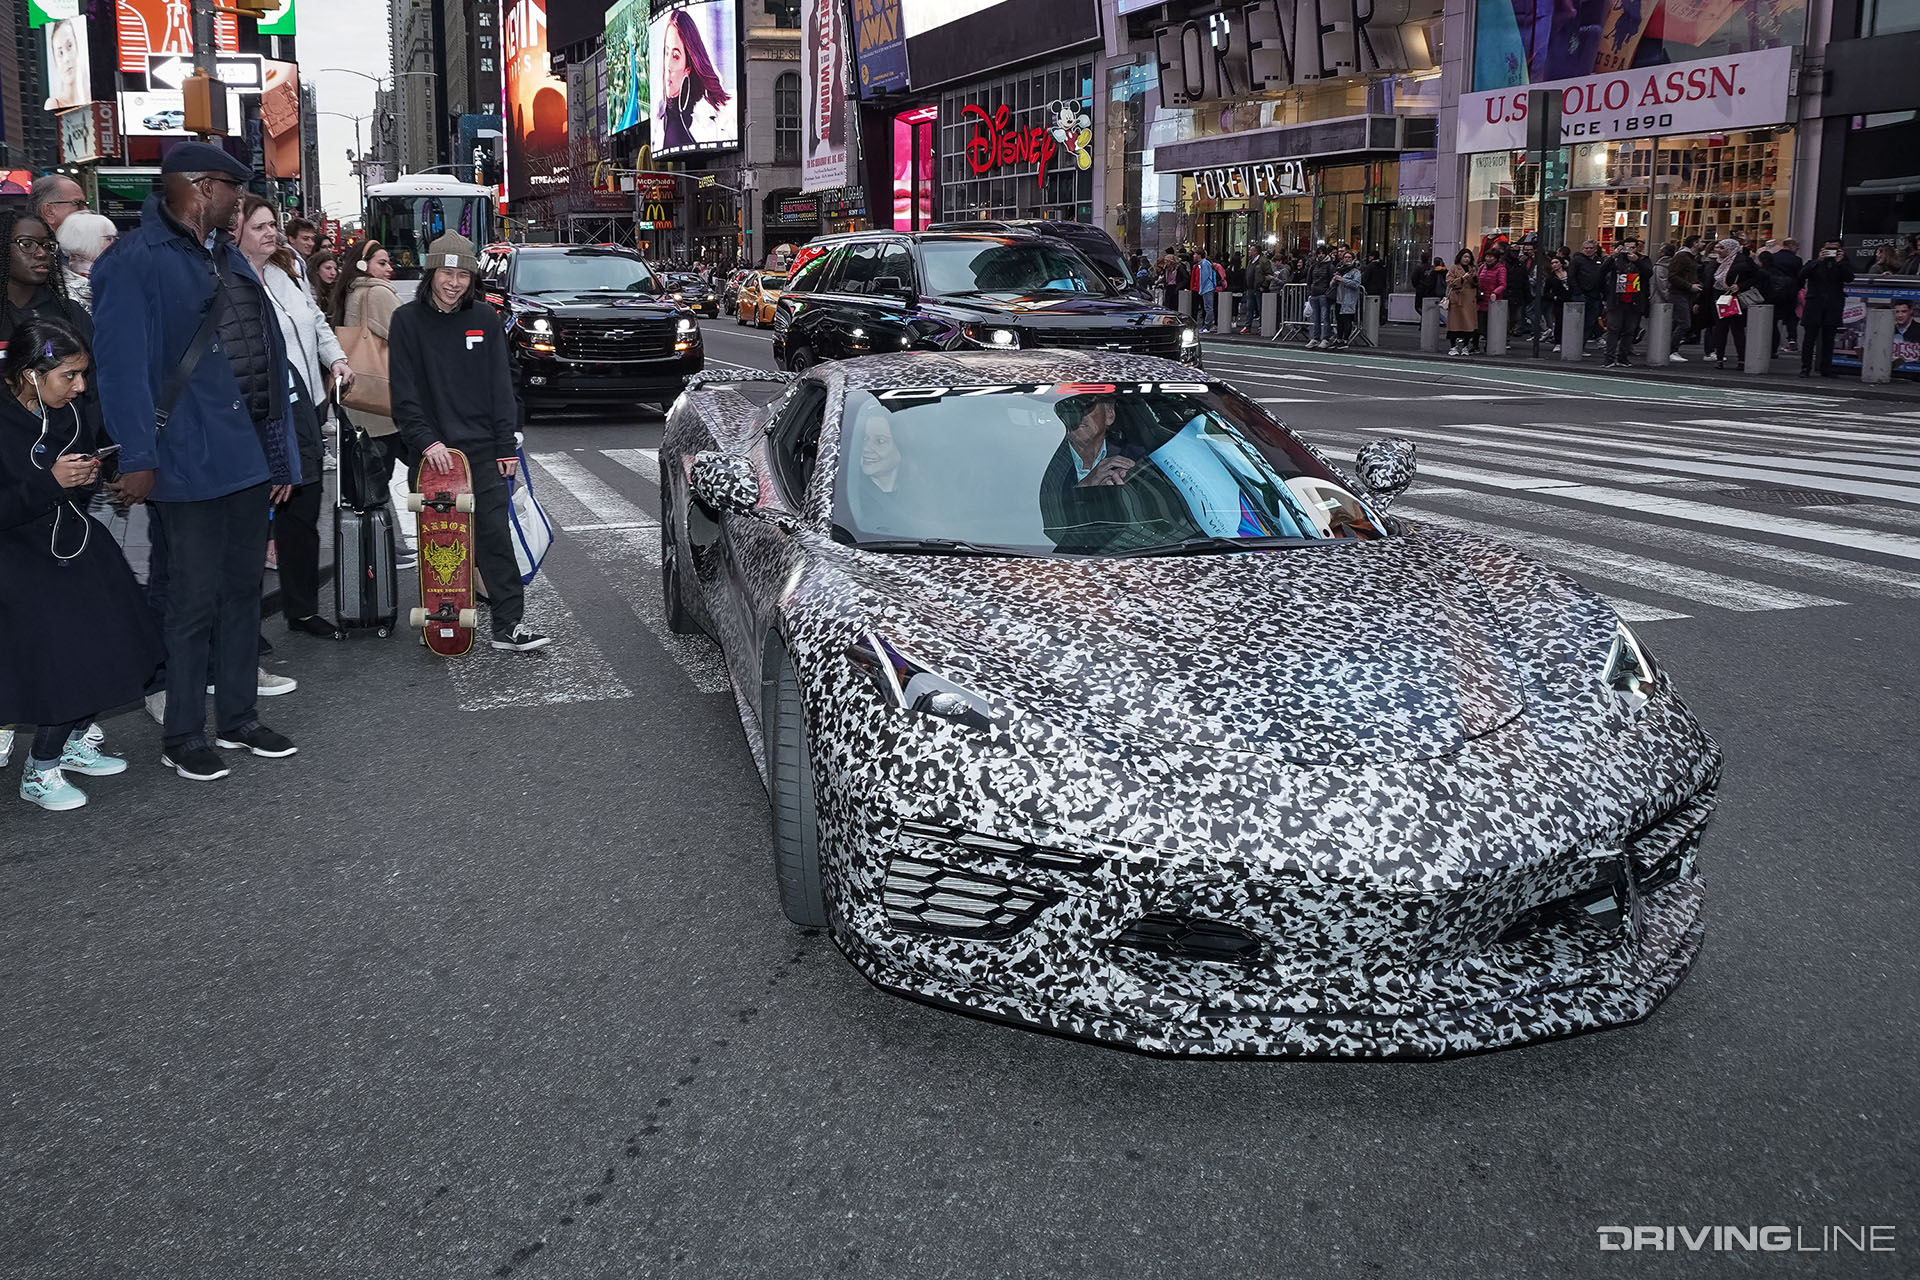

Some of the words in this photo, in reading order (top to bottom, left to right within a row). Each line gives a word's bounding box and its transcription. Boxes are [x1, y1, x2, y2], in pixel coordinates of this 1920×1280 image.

[820, 0, 830, 52] RETTY
[859, 6, 899, 53] AWAY
[765, 48, 785, 60] THE
[1154, 0, 1380, 109] FOREVER
[1595, 50, 1627, 71] USPA
[820, 64, 830, 140] WOMAN
[1485, 91, 1528, 125] U.S
[1561, 79, 1629, 116] OLO
[1638, 63, 1747, 107] ASSN.
[1561, 121, 1601, 137] NCE
[1612, 113, 1673, 132] 1890
[1193, 165, 1282, 200] FOREVER
[1285, 161, 1307, 195] 21
[784, 203, 815, 213] ELECTRONICS
[1856, 249, 1876, 257] NEW
[1862, 239, 1895, 247] ESCAPE
